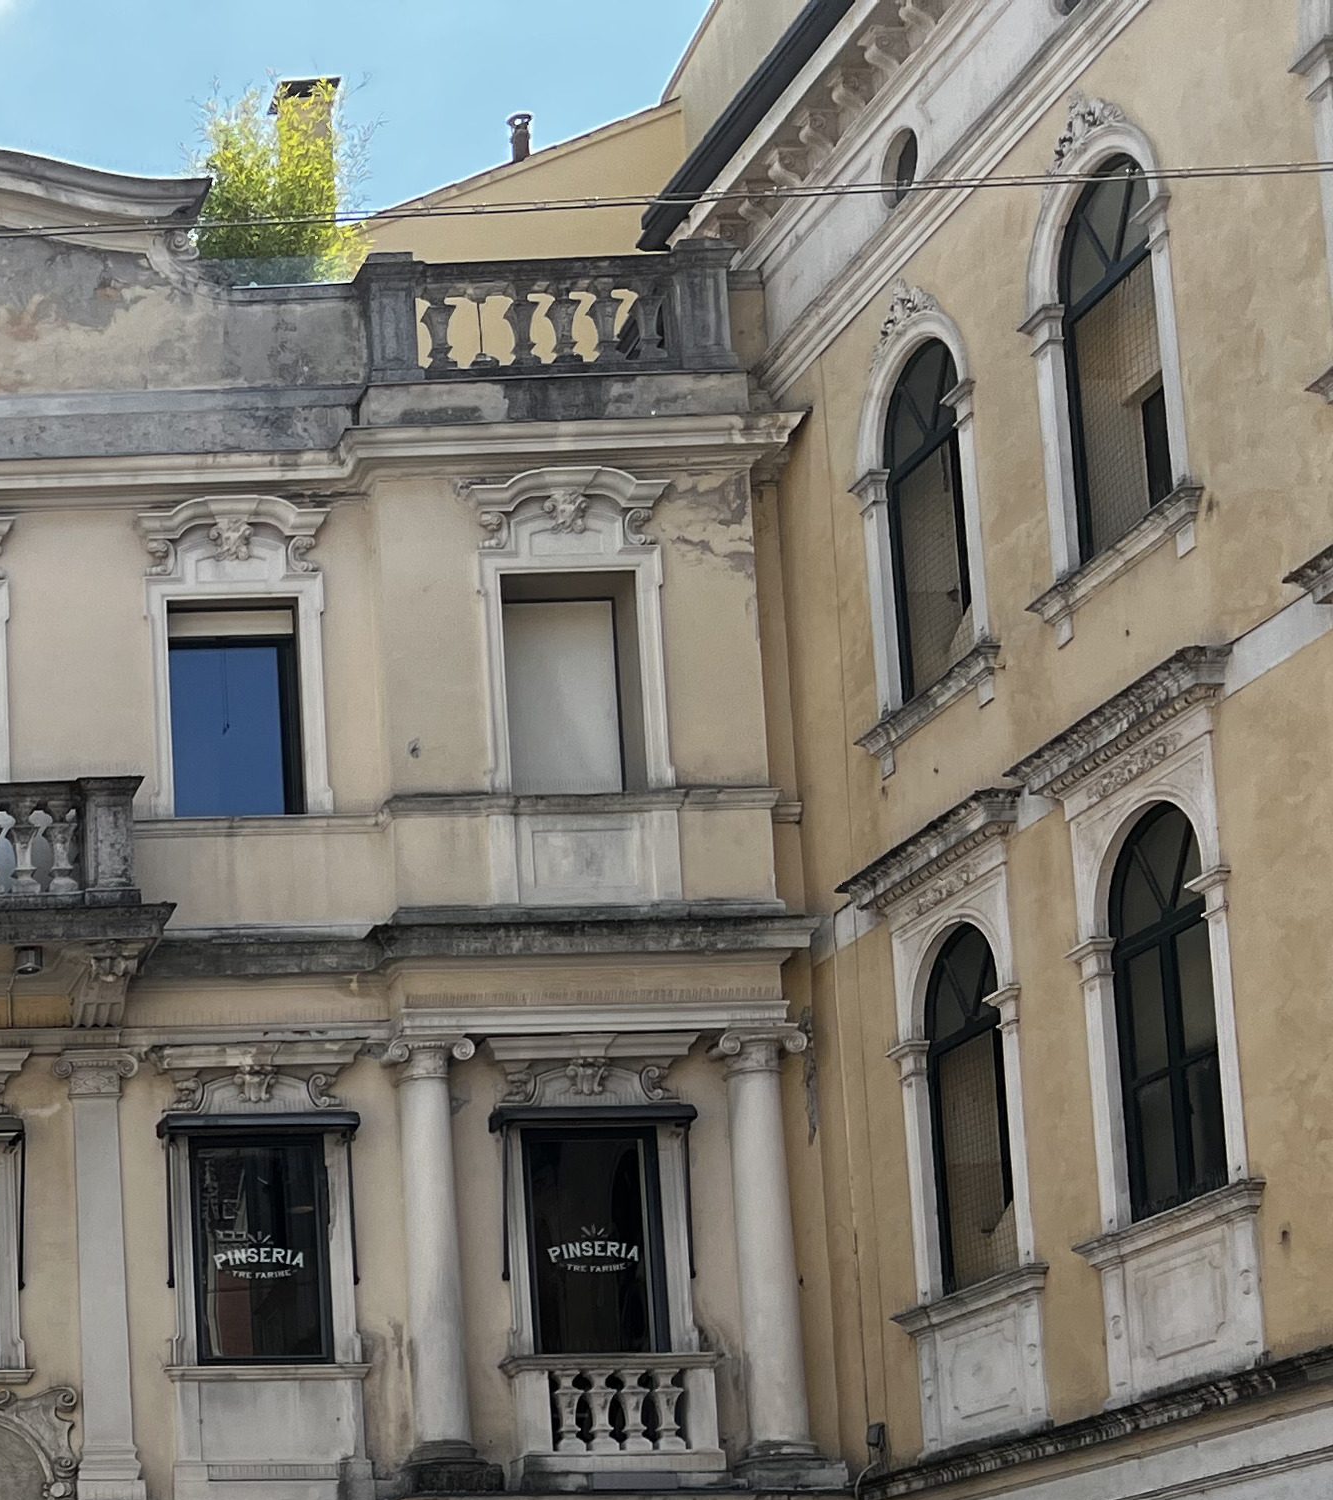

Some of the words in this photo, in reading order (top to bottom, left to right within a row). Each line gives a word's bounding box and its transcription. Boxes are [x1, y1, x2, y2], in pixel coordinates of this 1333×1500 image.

[213, 1247, 304, 1270] PINSERIA
[547, 1241, 639, 1263] PINSERIA
[232, 1270, 252, 1279] TRE
[255, 1269, 292, 1279] FARINE
[566, 1263, 587, 1273] TRE
[589, 1262, 626, 1273] FARINE
